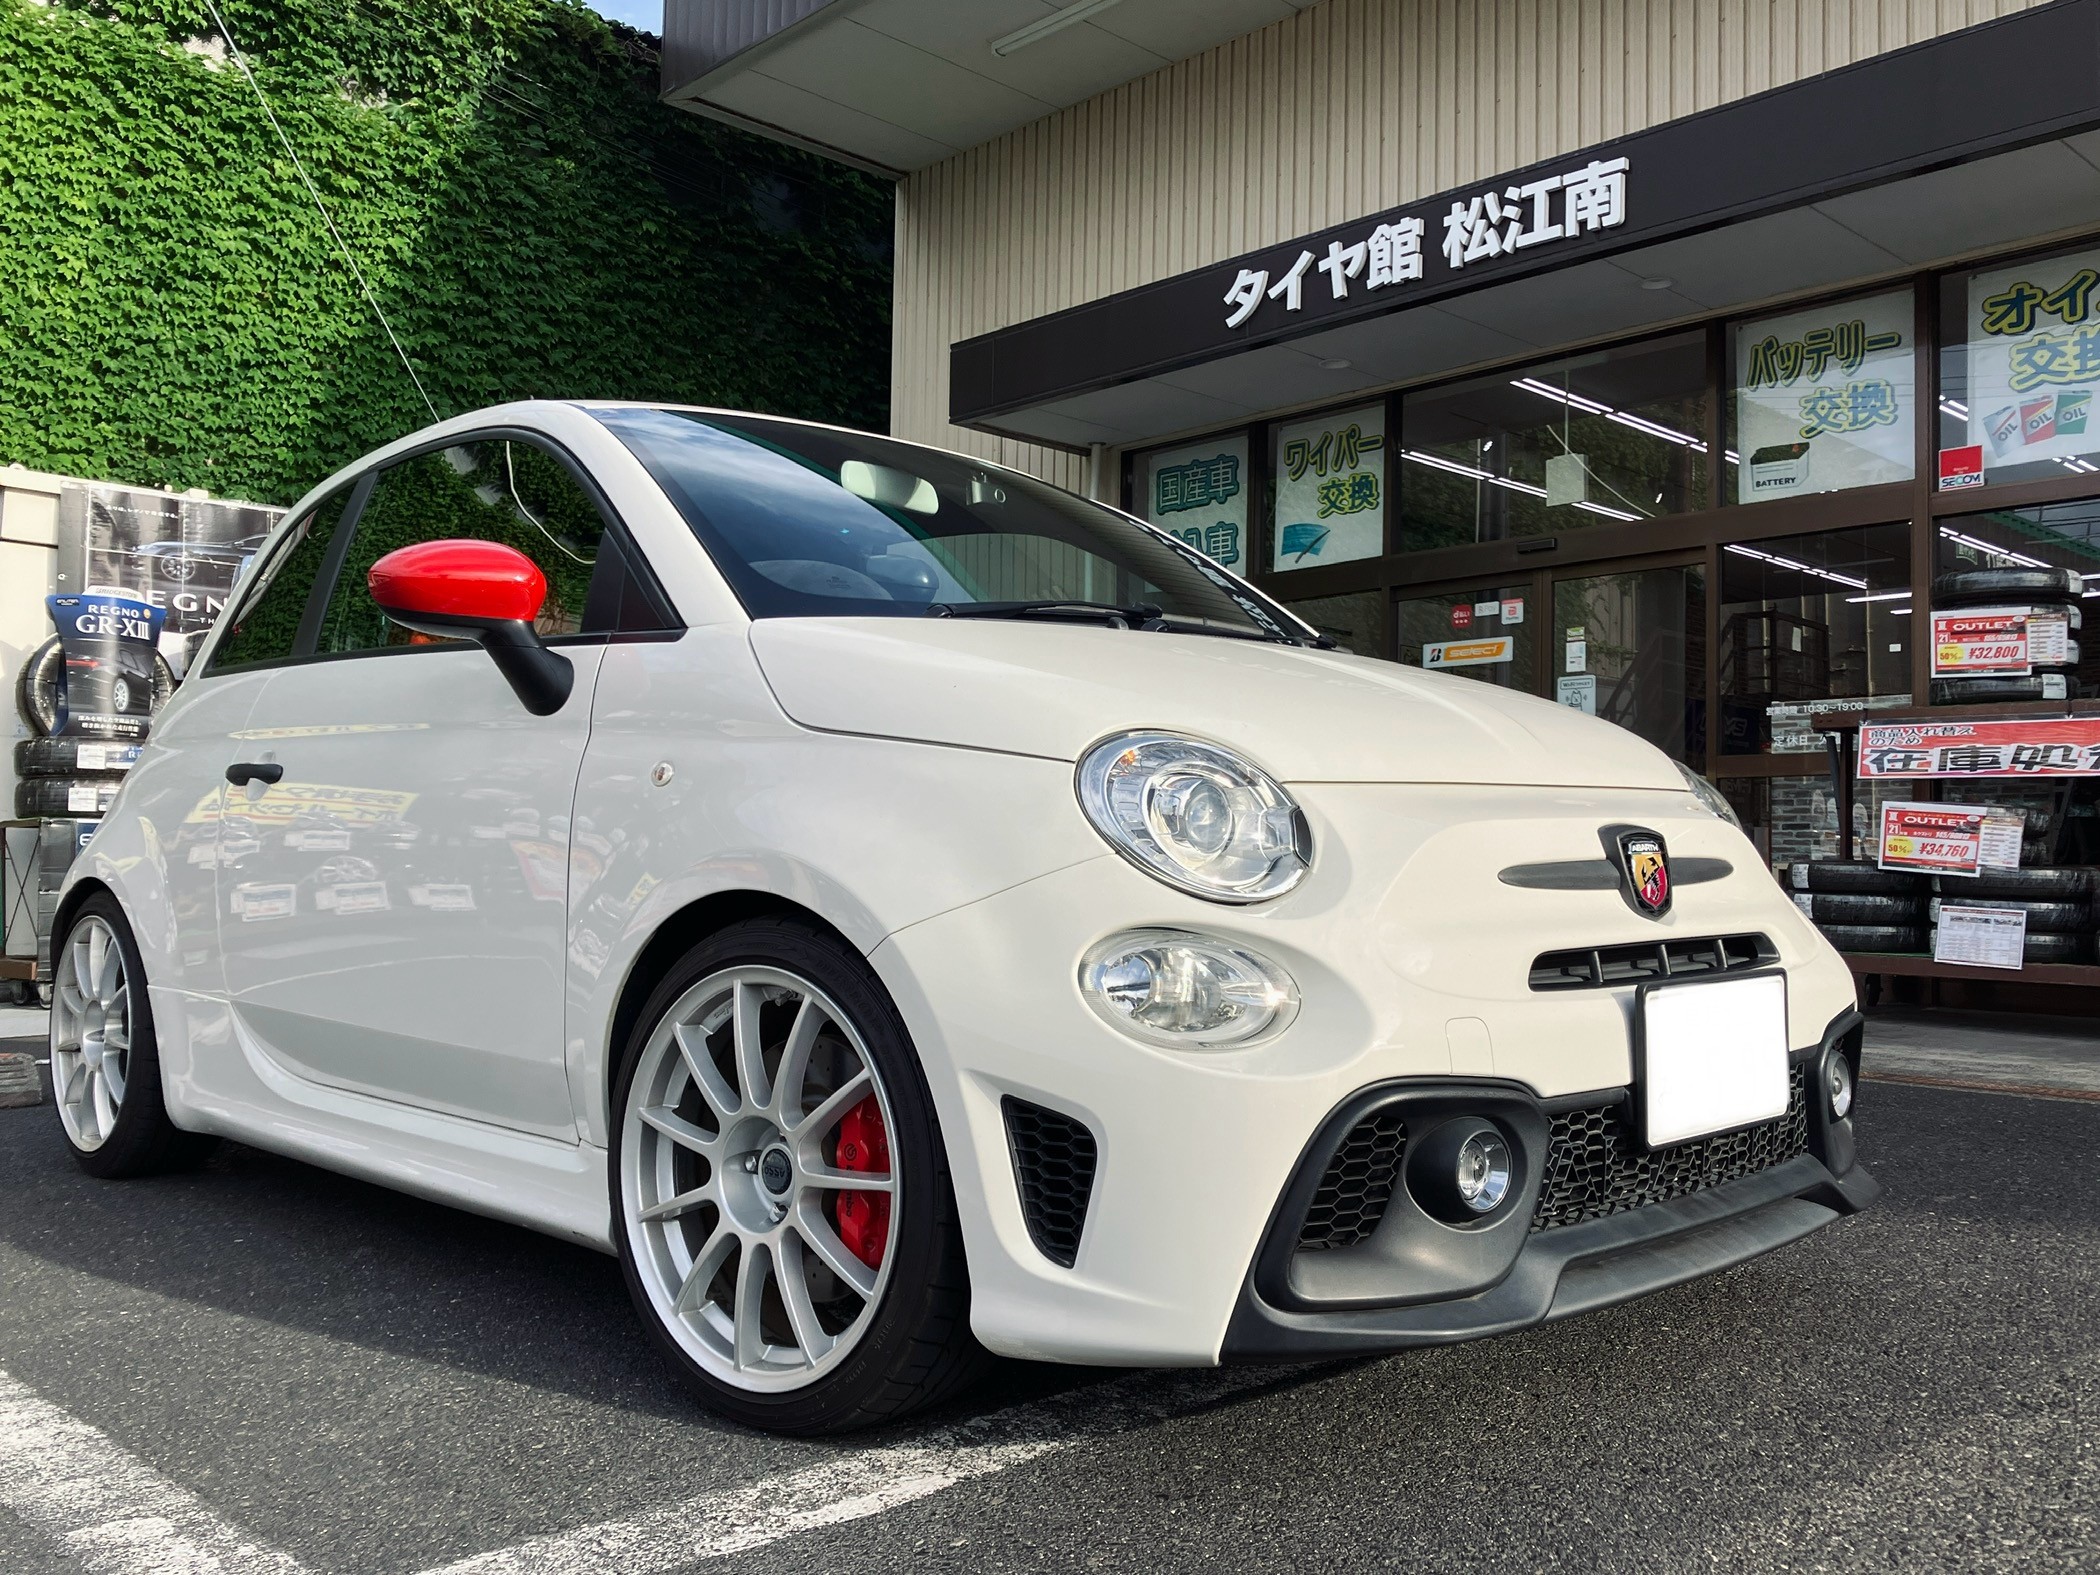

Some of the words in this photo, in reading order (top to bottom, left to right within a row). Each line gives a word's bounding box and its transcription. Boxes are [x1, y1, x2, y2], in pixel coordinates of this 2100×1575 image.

[1223, 216, 1425, 329] タイヤ館
[1442, 156, 1630, 270] 松江南
[1982, 268, 2100, 335] オイ
[1746, 319, 1901, 392] バッテリー
[1799, 378, 1898, 438] 交換
[2062, 404, 2088, 422] OIL
[2029, 410, 2053, 432] OIL
[1998, 424, 2019, 443] OIL
[1284, 424, 1385, 481] ワイパー
[1157, 453, 1240, 516] 国産車
[1755, 476, 1797, 489] BATTERY
[1941, 473, 1981, 488] SECOM
[1317, 472, 1380, 519] 交換
[88, 604, 139, 619] REGNO
[1952, 621, 2013, 631] OUTLET
[1938, 633, 1949, 643] 21
[1449, 644, 1499, 658] select
[1968, 645, 2020, 660] ¥32,800
[1870, 726, 1978, 739] 商品入れ替え
[1773, 735, 1808, 747] 定休日
[1869, 737, 1923, 746] のため
[1904, 816, 1967, 826] OUTLET
[1632, 843, 1659, 852] ABARTH
[1919, 842, 1970, 858] ¥34,760
